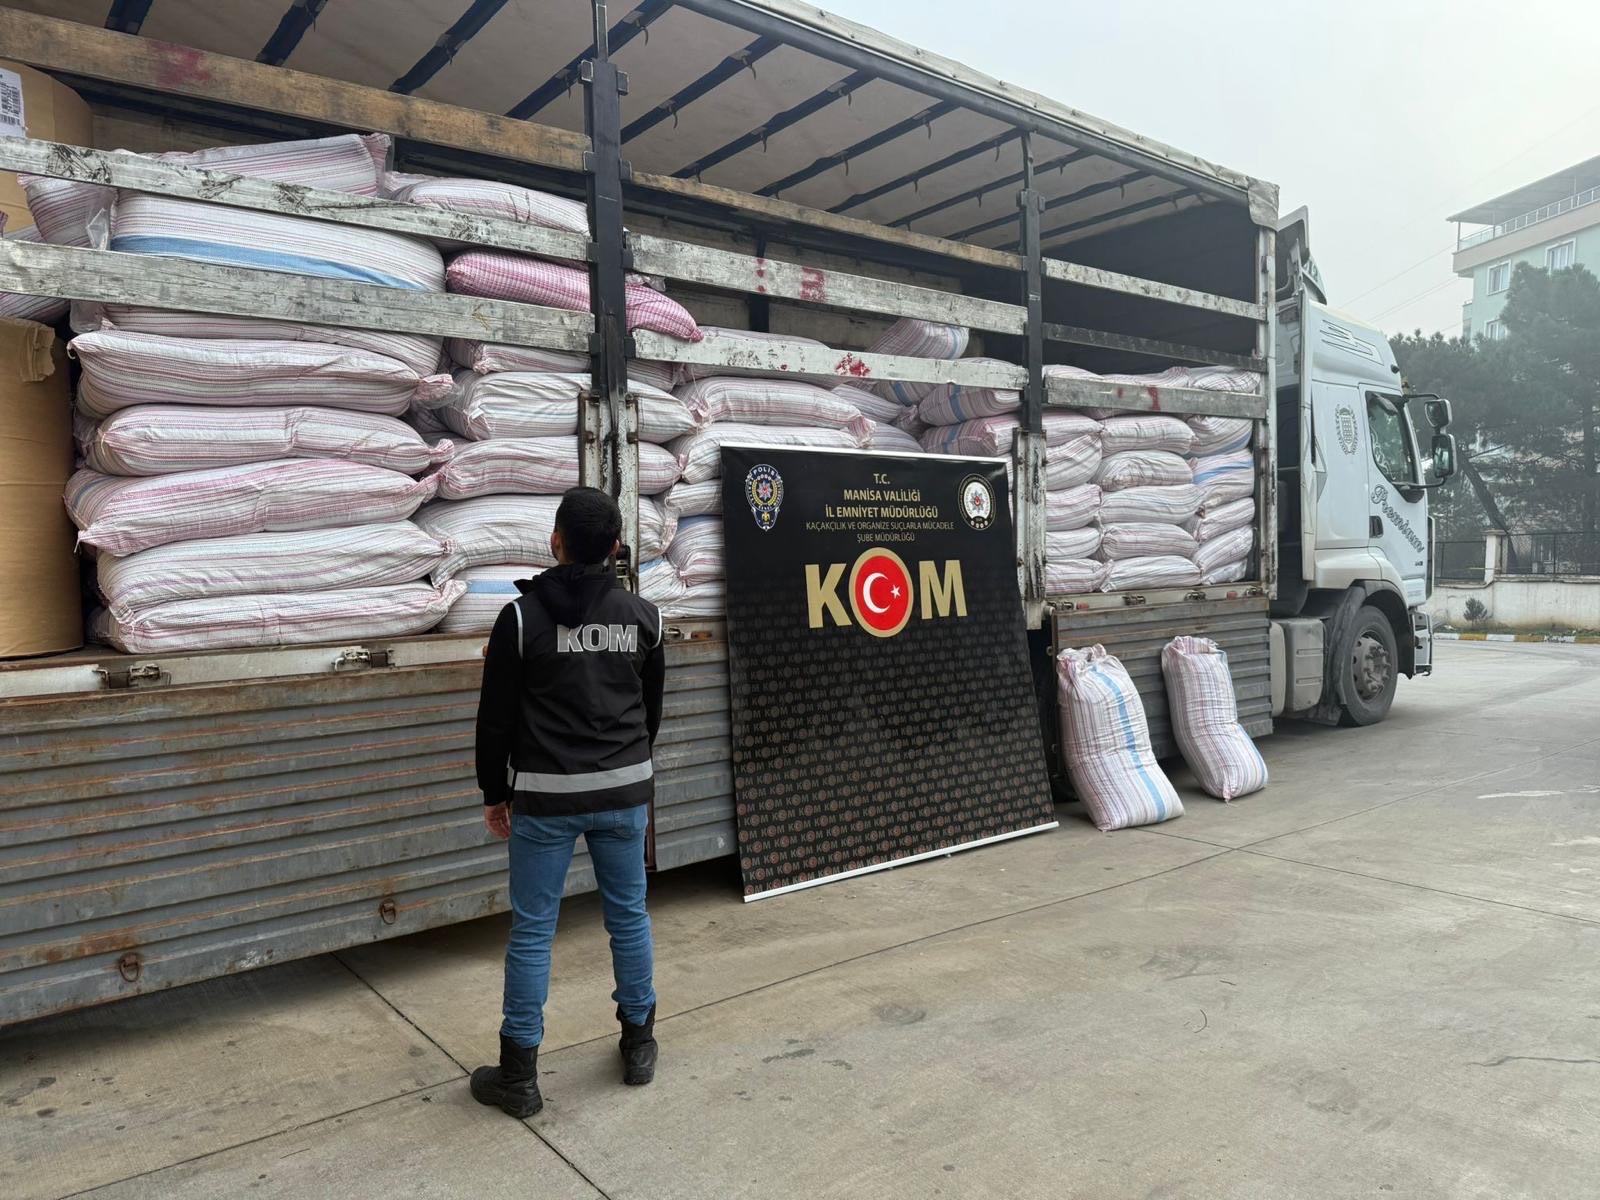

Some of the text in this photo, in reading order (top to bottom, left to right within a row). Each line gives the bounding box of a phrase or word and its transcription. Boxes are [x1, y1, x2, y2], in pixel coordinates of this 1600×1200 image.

[873, 473, 890, 485] T.C.
[843, 488, 921, 502] MANİSA VALİLİĞİ
[825, 504, 939, 518] İL EMNİYET MÜDÜRLÜĞÜ
[806, 521, 847, 532] KAÇAKÇILIK
[847, 521, 856, 530] VE
[890, 521, 921, 532] SUÇLARLA
[922, 520, 954, 530] MÜCADELE
[857, 533, 874, 544] ŞUBE
[556, 623, 639, 653] KOM
